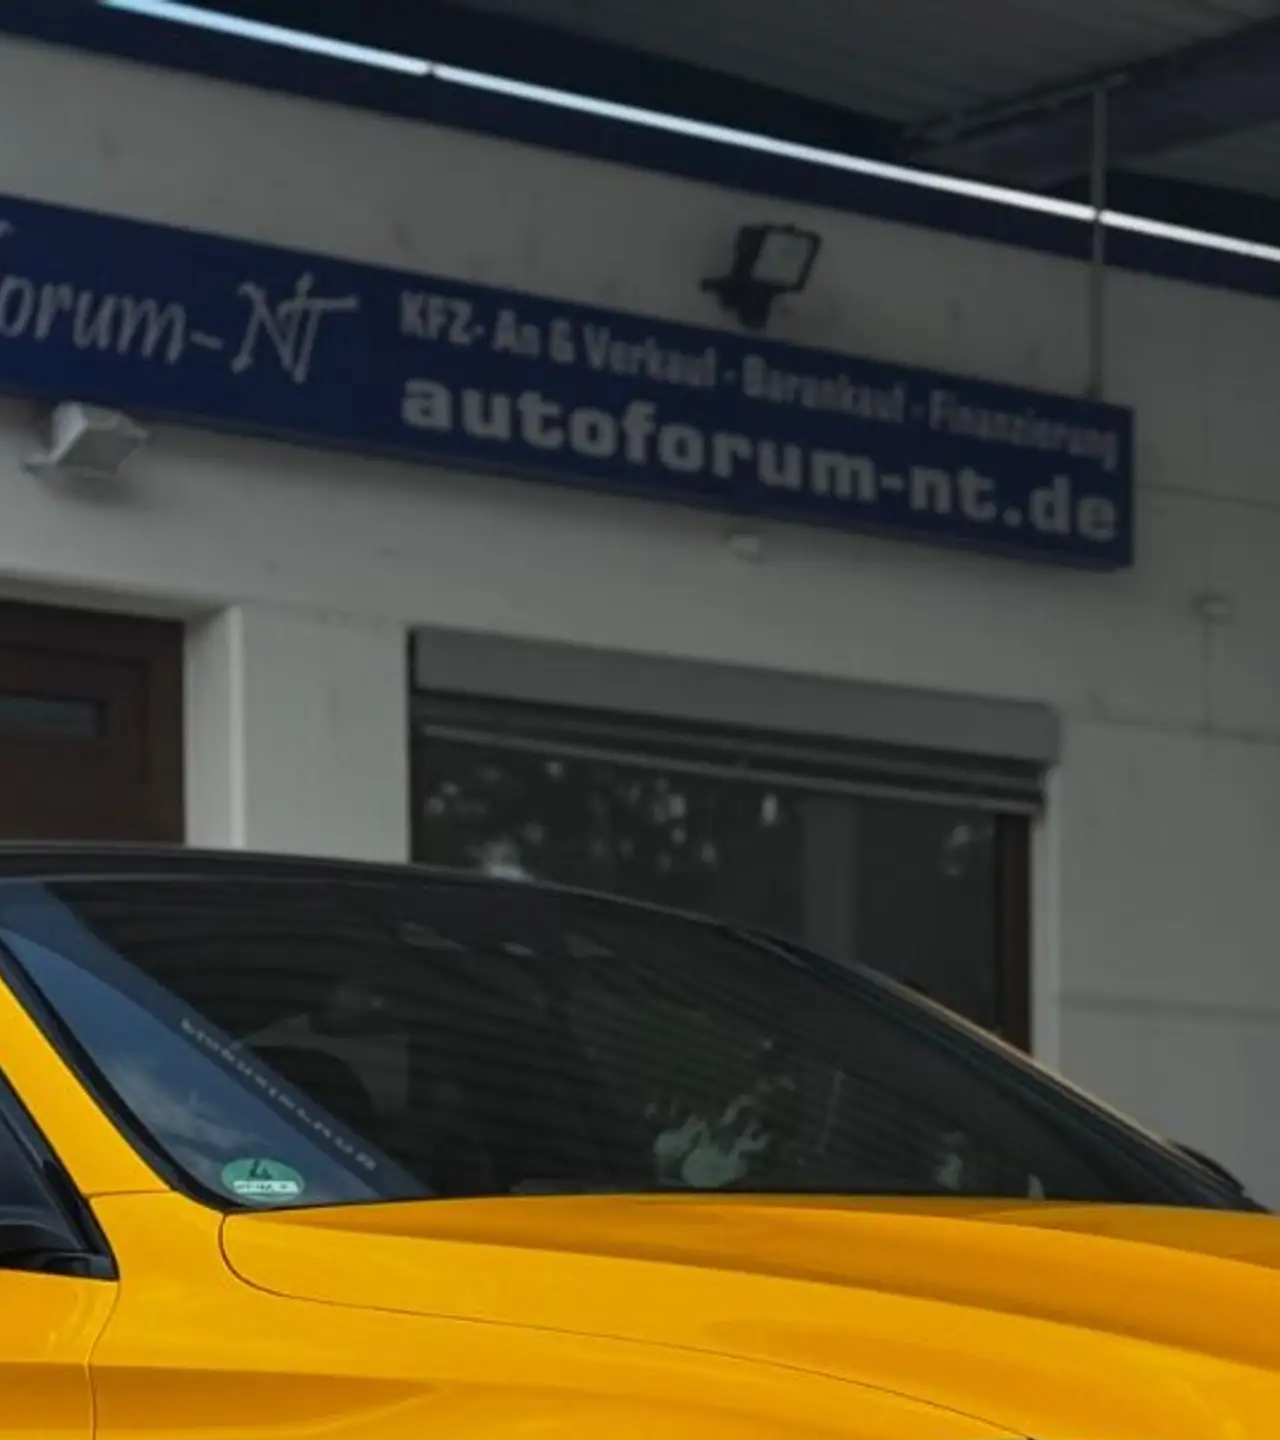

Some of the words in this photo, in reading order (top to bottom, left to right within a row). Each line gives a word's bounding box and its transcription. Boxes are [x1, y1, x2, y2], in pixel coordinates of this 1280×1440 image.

[401, 378, 1117, 542] autoforum-nt.de
[583, 323, 717, 388] Verkauf
[929, 388, 1118, 473] Finanzierung
